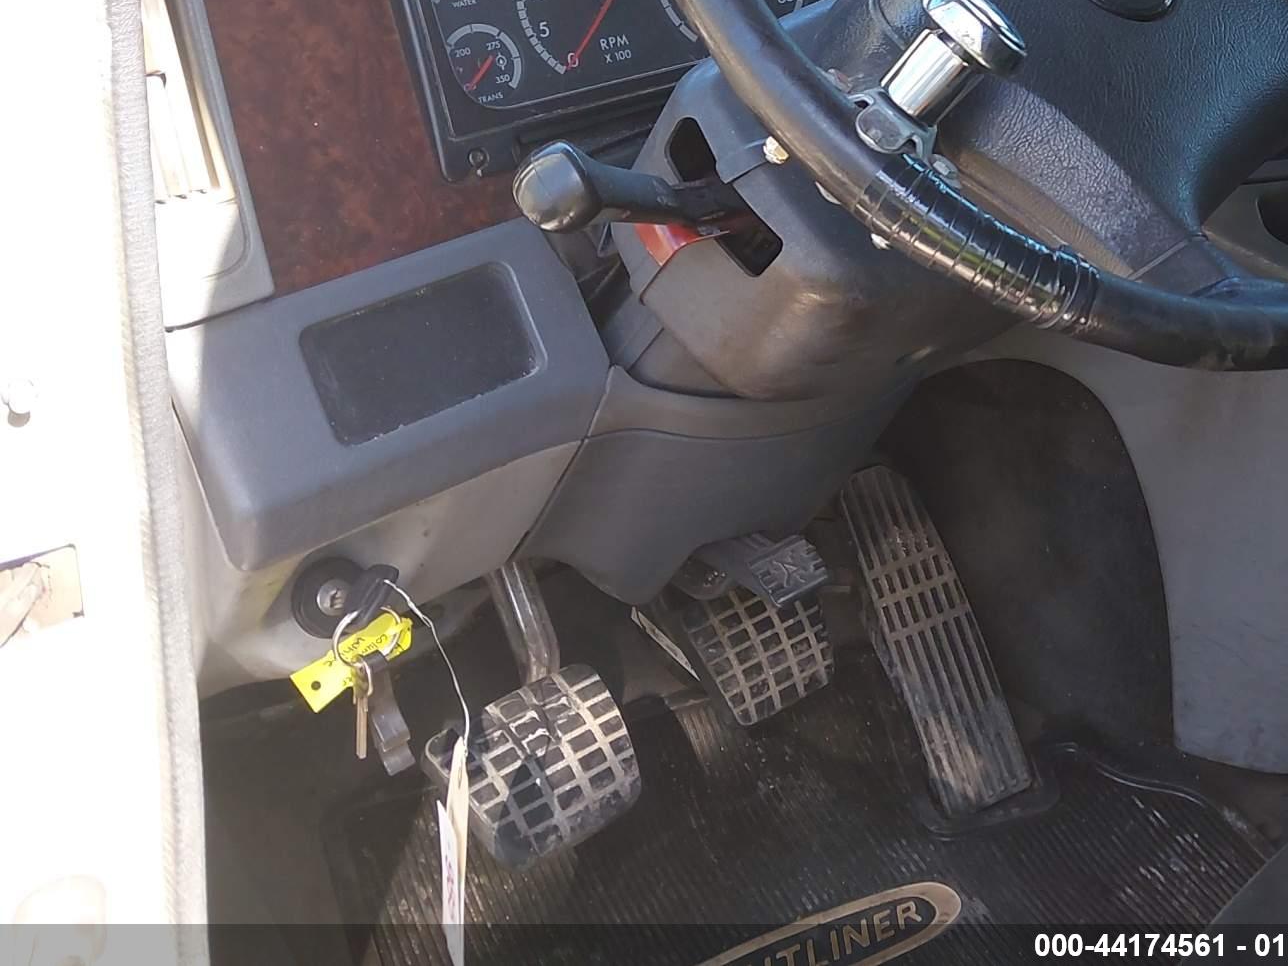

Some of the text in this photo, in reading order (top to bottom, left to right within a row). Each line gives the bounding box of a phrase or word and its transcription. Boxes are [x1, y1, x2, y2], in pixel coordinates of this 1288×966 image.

[538, 21, 550, 38] 5
[486, 41, 501, 51] 275
[599, 33, 630, 51] RPM
[454, 47, 471, 58] 200
[604, 48, 632, 64] X 100
[495, 74, 511, 84] 350
[477, 90, 504, 104] TRANS
